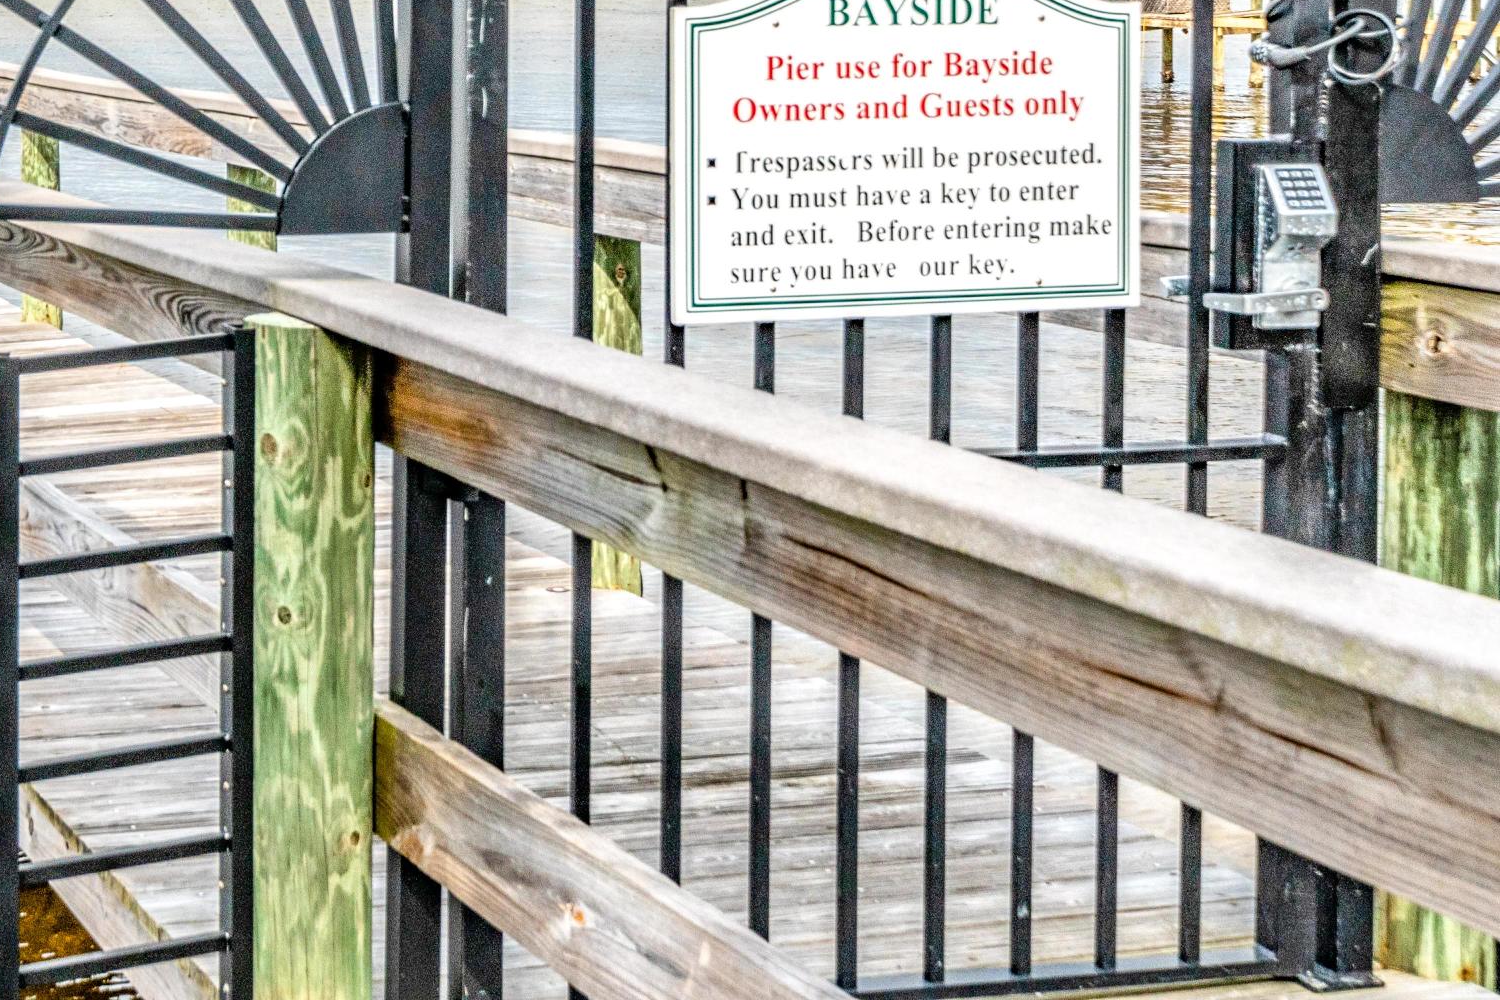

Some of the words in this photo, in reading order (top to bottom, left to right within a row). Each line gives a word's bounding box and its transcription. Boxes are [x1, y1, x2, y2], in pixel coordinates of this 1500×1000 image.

[766, 54, 825, 81] Pier
[836, 61, 881, 80] use
[892, 52, 933, 78] for
[944, 50, 1054, 83] Bayside
[732, 97, 845, 123] Owners
[856, 93, 909, 120] and
[919, 92, 1015, 118] Guests
[1025, 90, 1084, 121] only
[882, 147, 924, 169] will
[933, 147, 959, 168] be
[968, 143, 1102, 174] prosecuted.
[731, 187, 780, 210] You
[789, 187, 847, 208] must
[857, 185, 911, 206] have
[920, 189, 931, 204] a
[941, 182, 980, 210] key
[990, 184, 1010, 202] to
[1019, 182, 1080, 201] enter
[731, 223, 774, 247] and
[784, 222, 834, 246] exit.
[858, 219, 935, 242] Before
[944, 216, 1041, 244] entering
[1050, 214, 1112, 236] make
[730, 265, 782, 284] sure
[791, 264, 832, 288] you
[842, 258, 897, 280] have
[969, 254, 1015, 281] key.
